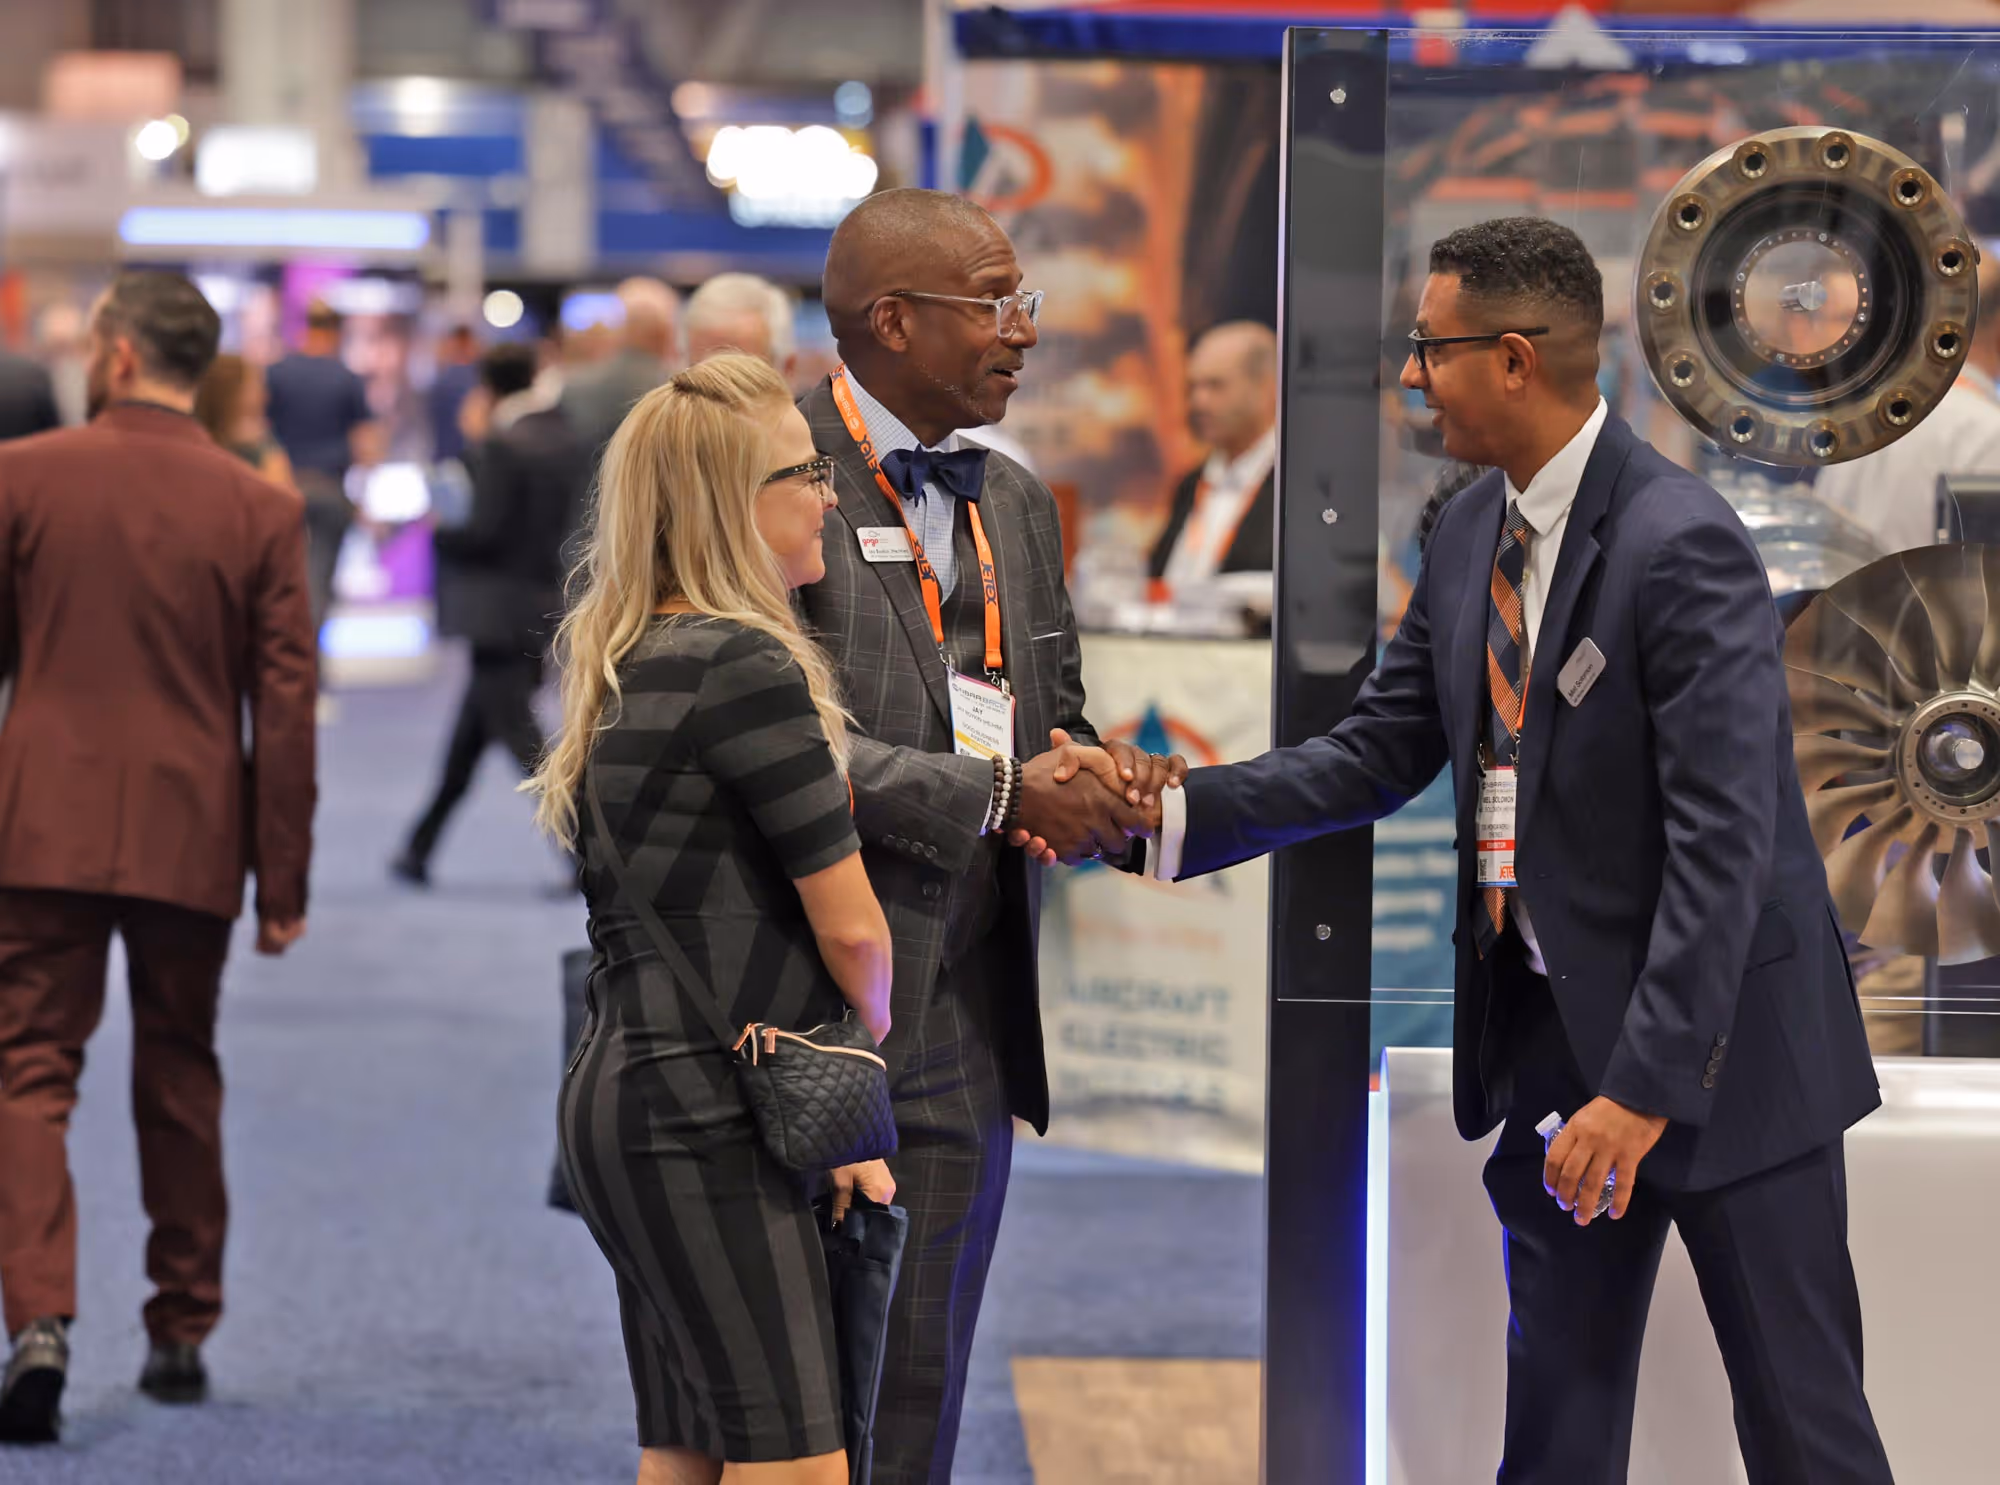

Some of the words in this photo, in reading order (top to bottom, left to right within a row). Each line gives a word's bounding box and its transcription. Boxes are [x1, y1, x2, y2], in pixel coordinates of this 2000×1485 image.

[862, 538, 879, 547] gogo
[980, 559, 997, 606] JETEX
[972, 706, 983, 715] JAY
